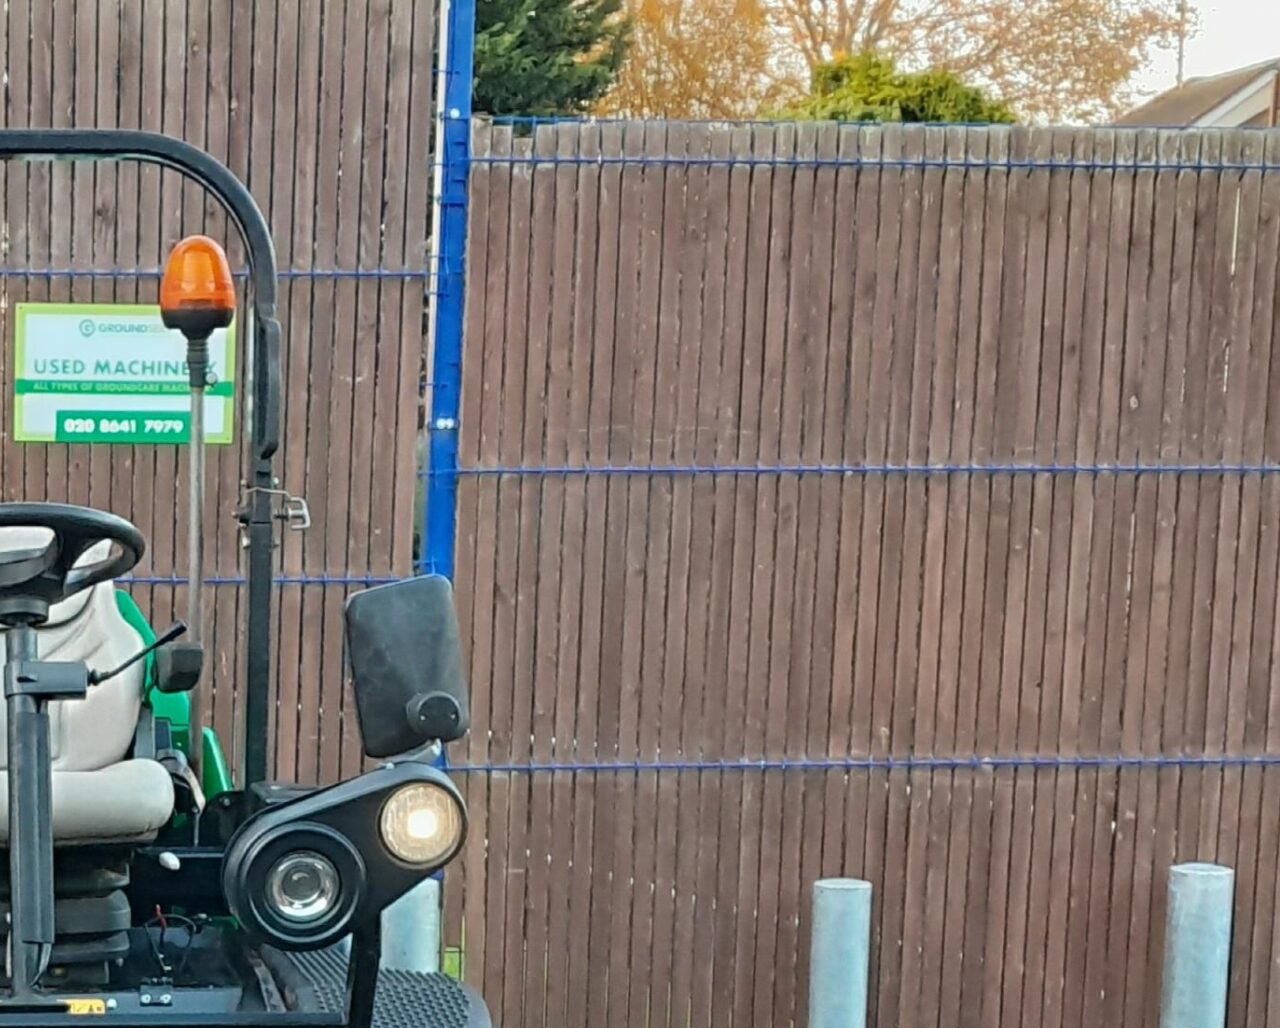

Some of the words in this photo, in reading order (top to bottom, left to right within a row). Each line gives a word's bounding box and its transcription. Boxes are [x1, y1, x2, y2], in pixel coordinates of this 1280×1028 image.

[34, 359, 85, 375] USED
[94, 359, 217, 376] MACHINEY
[63, 418, 95, 433] 020
[99, 418, 136, 433] 8641
[144, 418, 184, 433] 7979
